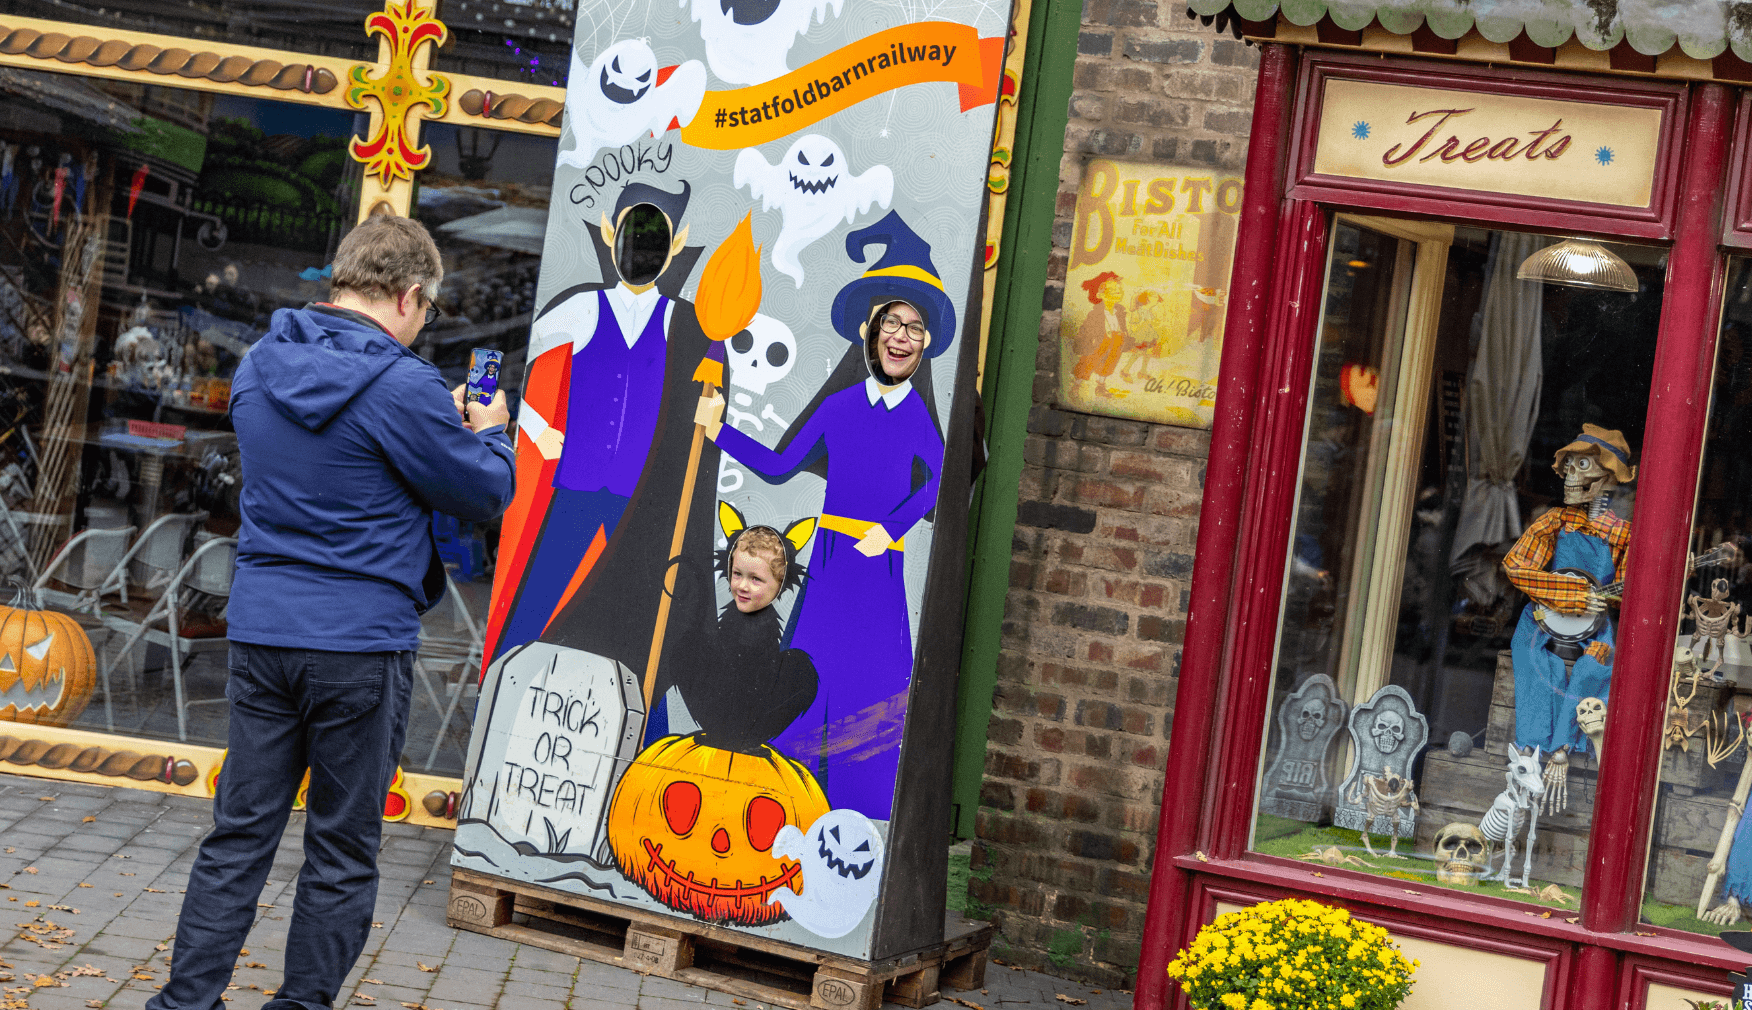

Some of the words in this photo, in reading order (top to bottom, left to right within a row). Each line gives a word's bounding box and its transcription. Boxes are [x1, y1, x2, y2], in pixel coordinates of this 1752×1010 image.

[715, 42, 957, 128] #statfoldbarnrailway
[1382, 107, 1572, 168] Treats
[570, 141, 673, 208] SPOOKY
[1068, 158, 1245, 271] BISTO
[1132, 218, 1157, 236] For
[1157, 220, 1182, 239] All
[1114, 237, 1153, 257] Meat
[1154, 240, 1204, 261] Dishes
[1144, 378, 1175, 393] Ah!
[1175, 379, 1216, 399] Bisto
[529, 686, 601, 738] TRICK
[534, 731, 573, 771] OR
[505, 761, 593, 816] TREAT
[456, 899, 480, 918] EPAL
[822, 982, 849, 1003] EPAL
